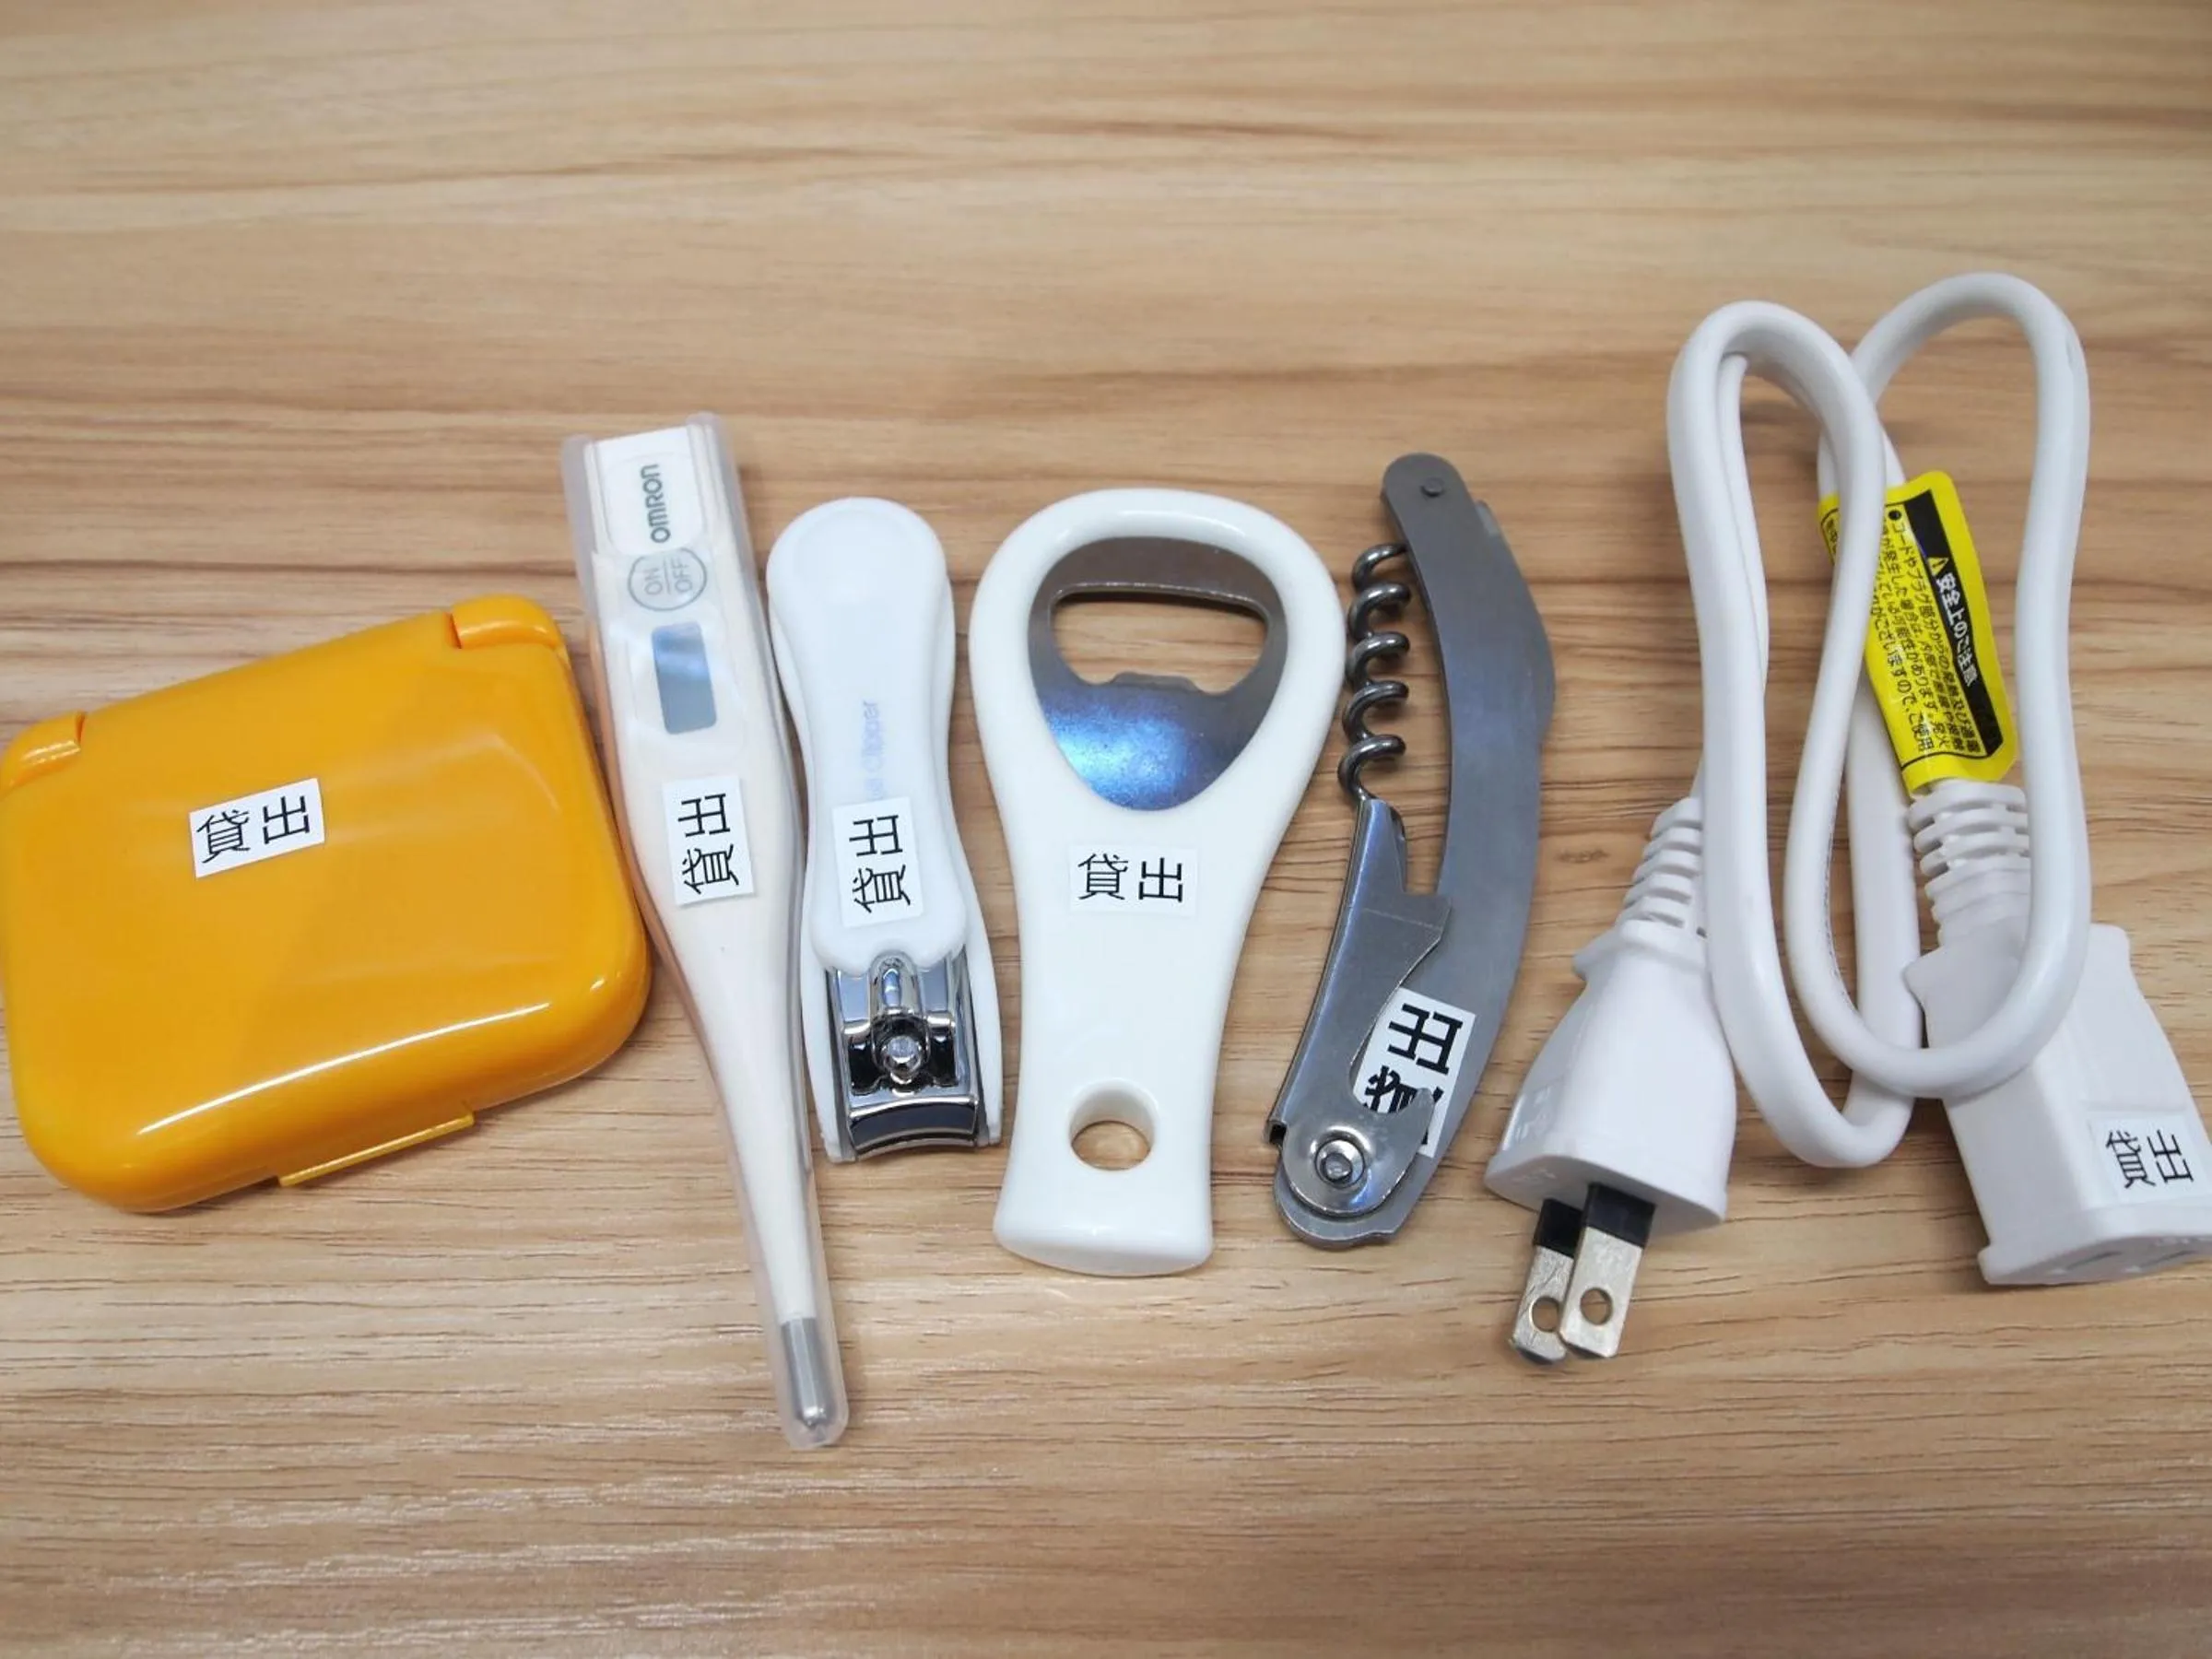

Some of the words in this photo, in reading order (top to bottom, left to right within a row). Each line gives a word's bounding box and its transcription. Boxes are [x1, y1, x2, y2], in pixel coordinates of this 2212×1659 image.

[644, 567, 663, 595] ON
[671, 557, 693, 594] OFF
[1936, 571, 1979, 688] 安全上のご注意
[197, 795, 311, 864] 貸出
[677, 793, 739, 896] 貸出
[849, 815, 911, 913] 貸出
[1077, 852, 1184, 904] 貸出
[2104, 1128, 2194, 1190] 貸出
